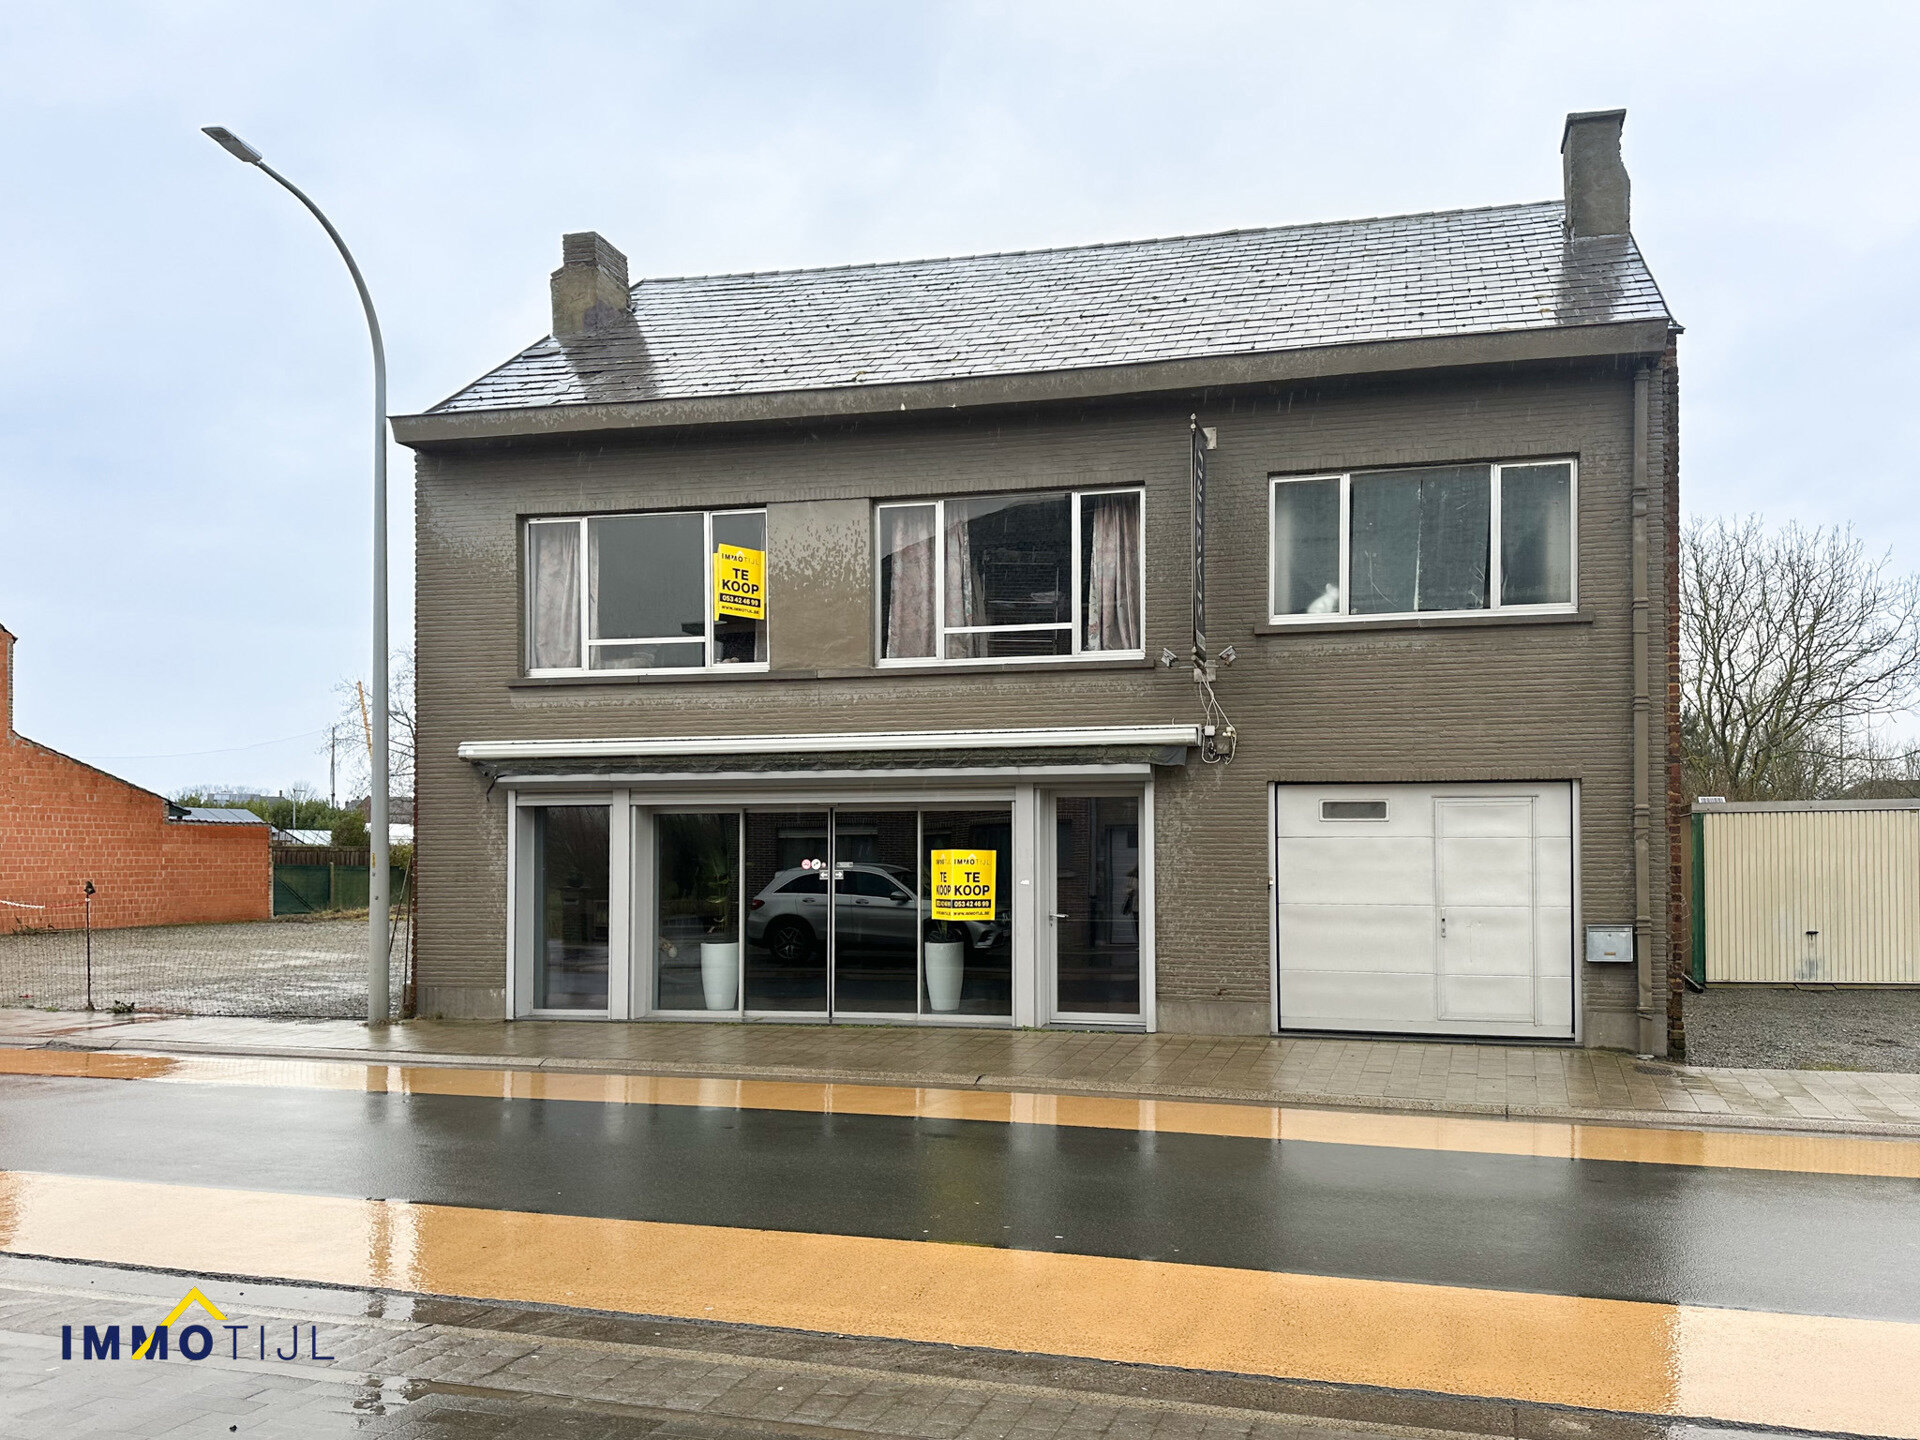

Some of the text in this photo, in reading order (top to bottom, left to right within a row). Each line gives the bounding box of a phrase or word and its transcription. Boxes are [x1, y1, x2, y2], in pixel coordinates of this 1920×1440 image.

[1195, 448, 1205, 620] SLAGERIJ
[732, 568, 749, 581] TE
[722, 579, 759, 594] KOOP
[722, 594, 733, 602] 053
[735, 596, 743, 604] 42
[940, 872, 947, 882] TE
[964, 872, 980, 882] TE
[954, 885, 990, 896] KOOP
